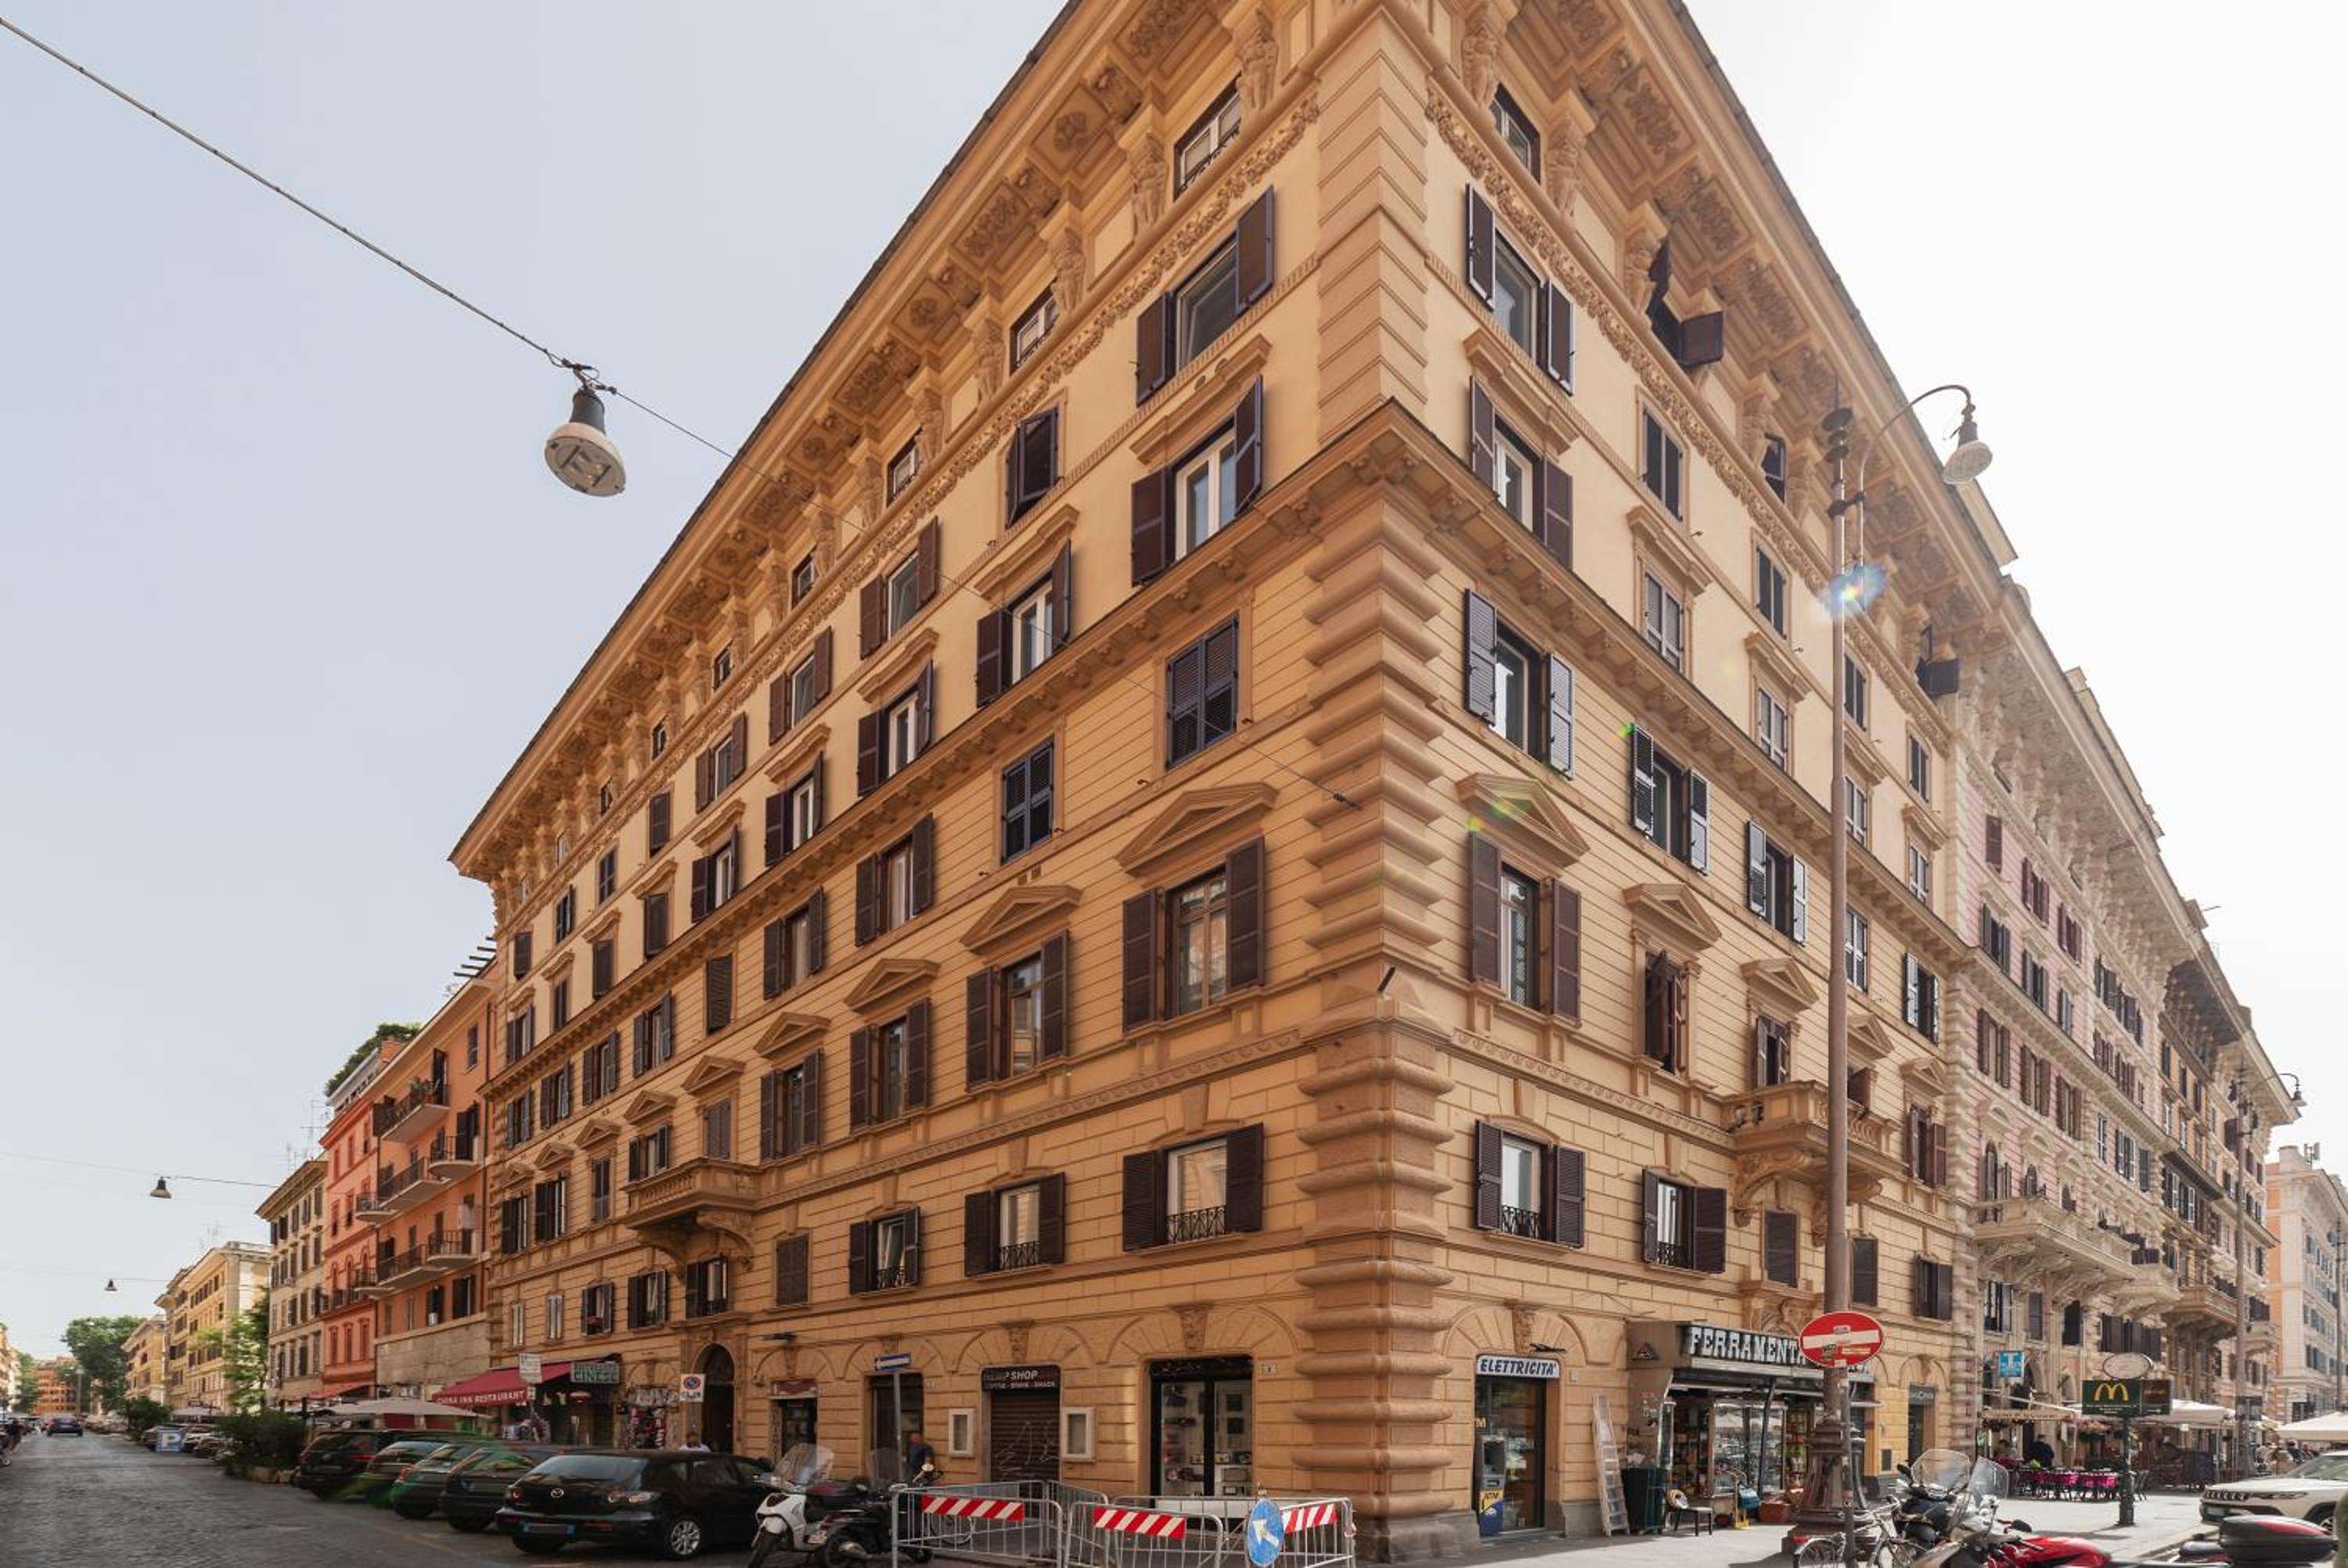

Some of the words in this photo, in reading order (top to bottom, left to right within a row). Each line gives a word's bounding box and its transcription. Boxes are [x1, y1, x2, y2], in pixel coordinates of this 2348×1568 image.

[1480, 1359, 1556, 1376] ELETTRICITA'
[1010, 1370, 1039, 1380] SHOP
[161, 1433, 181, 1447] P
